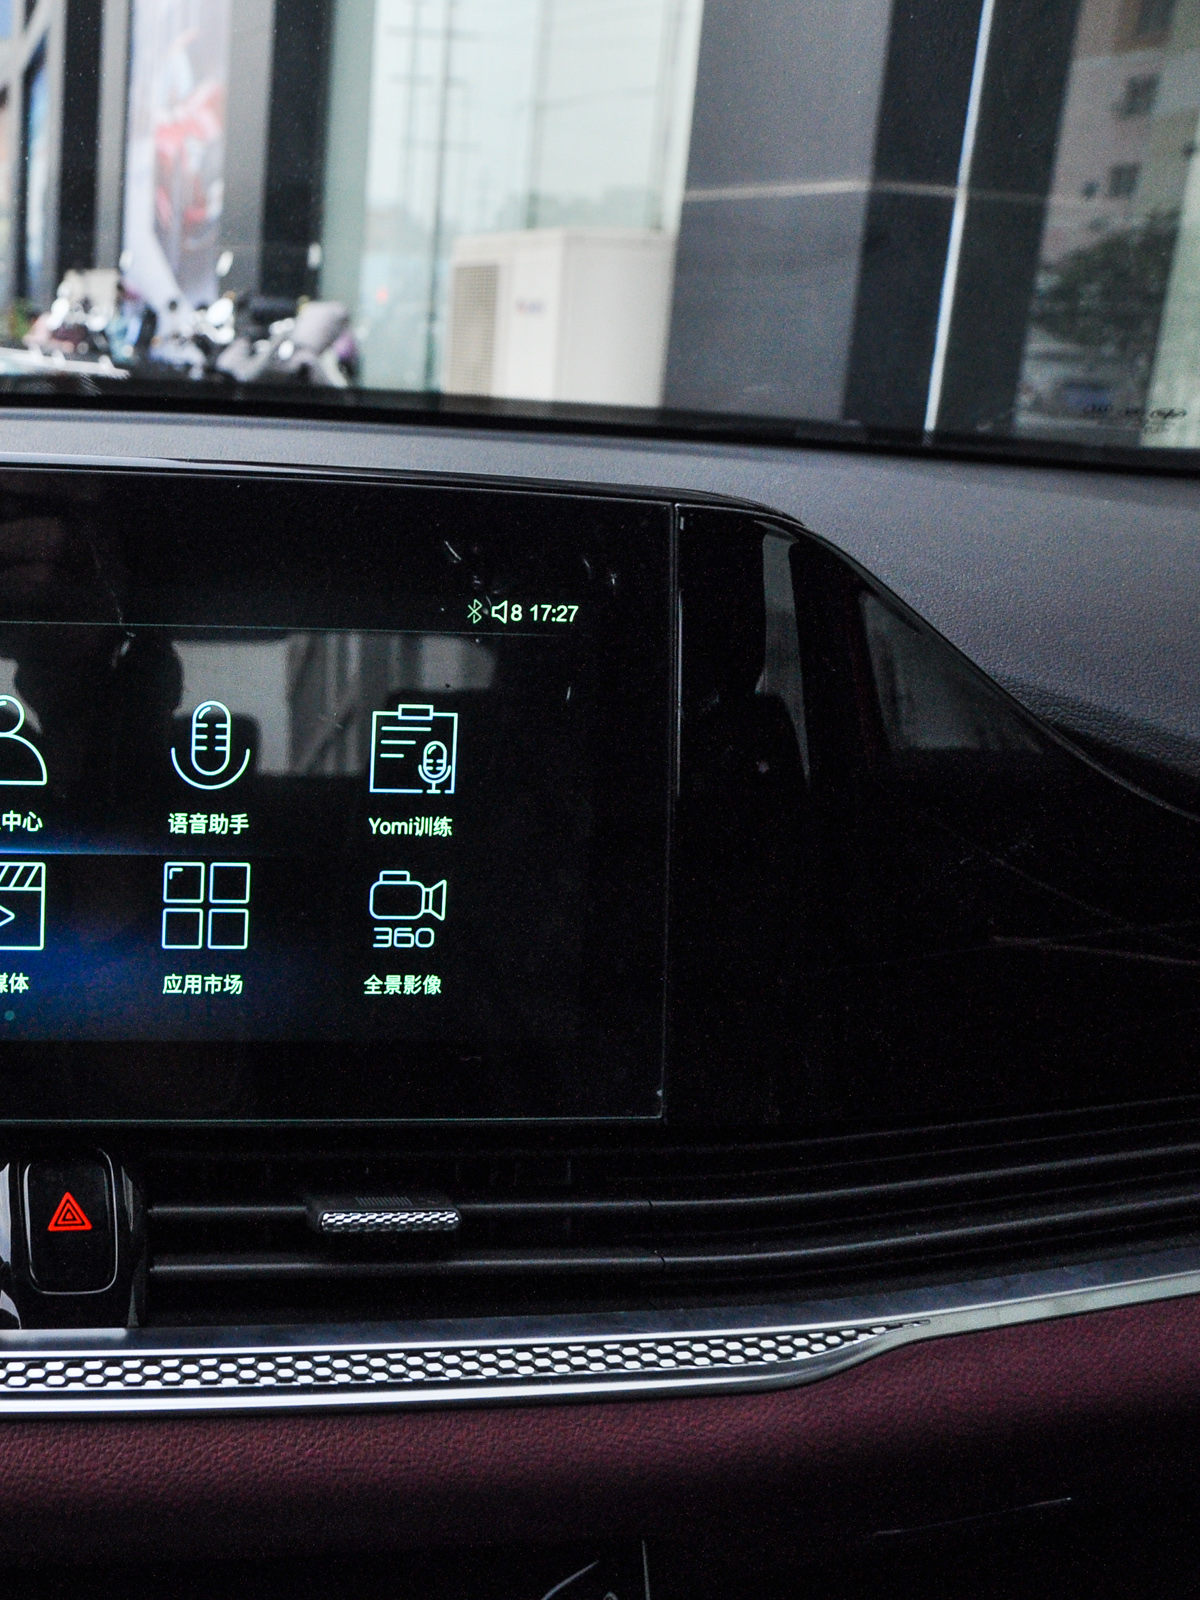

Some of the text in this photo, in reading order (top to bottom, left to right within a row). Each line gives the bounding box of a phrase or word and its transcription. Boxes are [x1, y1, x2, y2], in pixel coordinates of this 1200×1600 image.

[510, 604, 579, 623] 8 17:27
[167, 812, 250, 835] 语音助手
[368, 815, 453, 838] Yomi训练
[372, 926, 435, 949] 360
[162, 972, 244, 995] 应用市场
[363, 974, 442, 996] 全景影像
